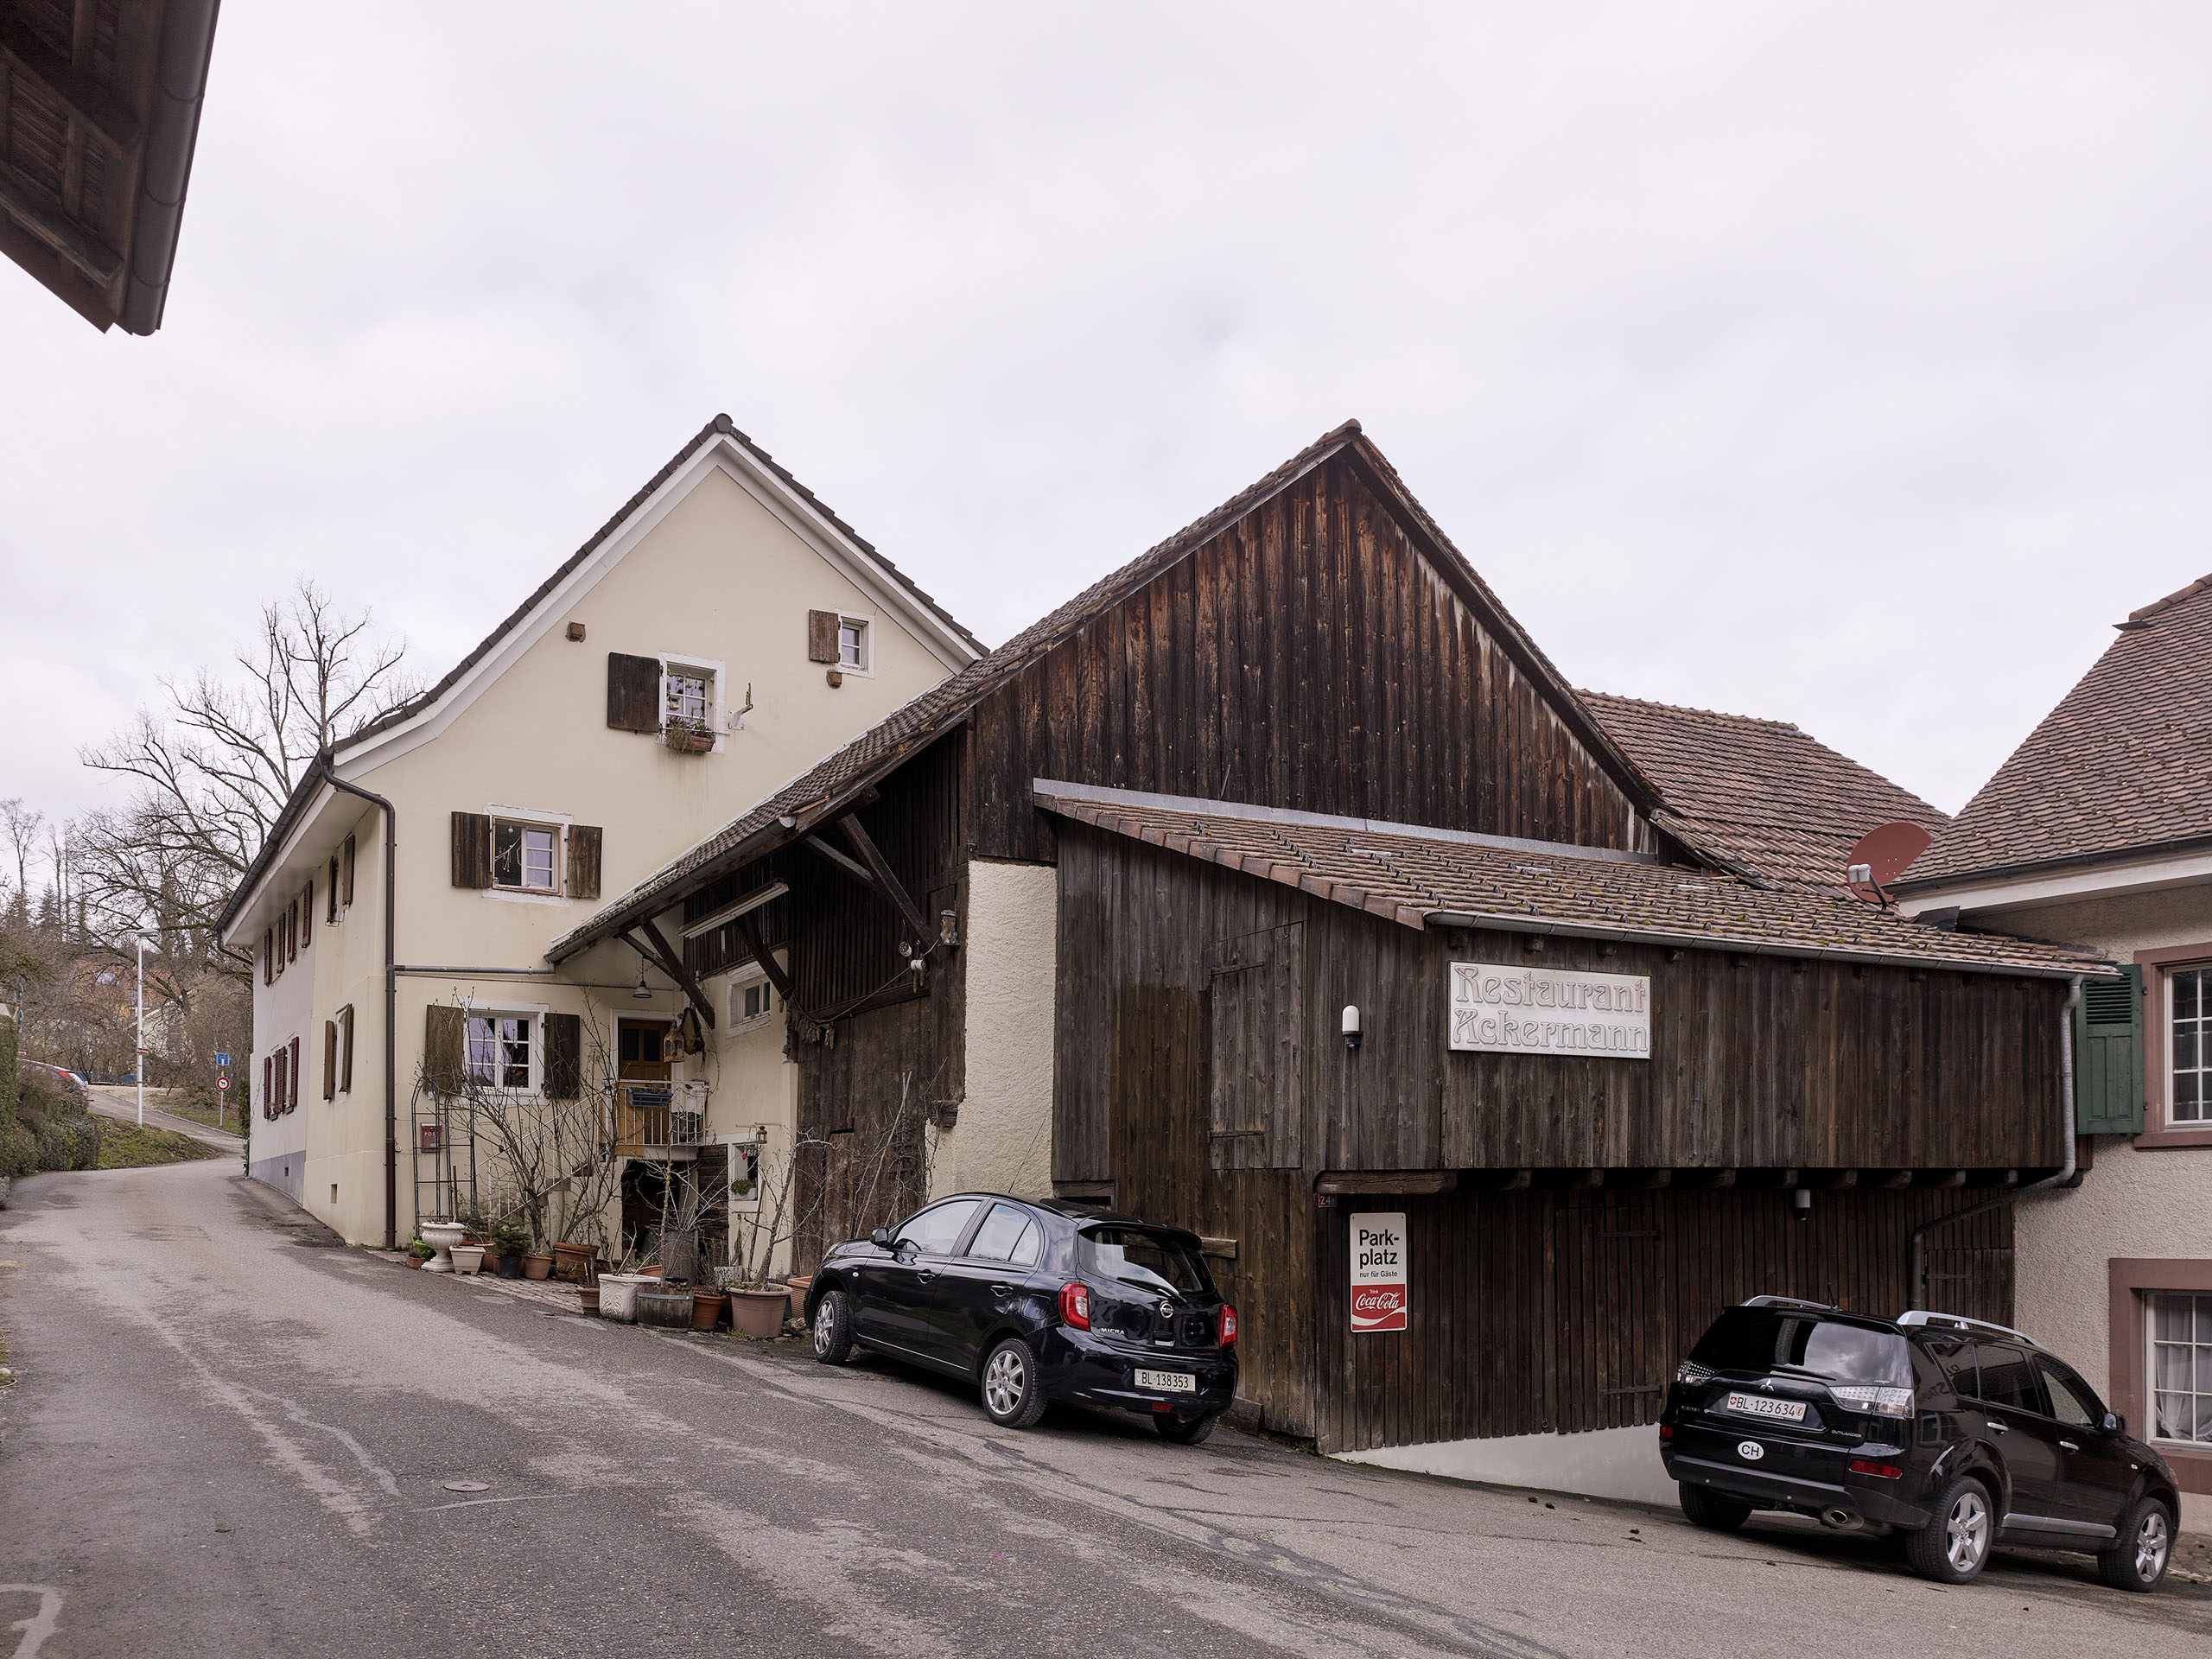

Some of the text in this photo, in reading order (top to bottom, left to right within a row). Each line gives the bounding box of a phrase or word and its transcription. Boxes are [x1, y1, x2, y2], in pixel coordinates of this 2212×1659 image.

[1454, 965, 1645, 1012] Restaurant
[1453, 1008, 1648, 1051] Ackermann
[1359, 1229, 1400, 1246] Park-
[1359, 1249, 1398, 1269] platz
[1356, 1292, 1401, 1311] Coca-Cola
[1100, 1327, 1125, 1336] MICRA
[1741, 1444, 1760, 1458] CH
